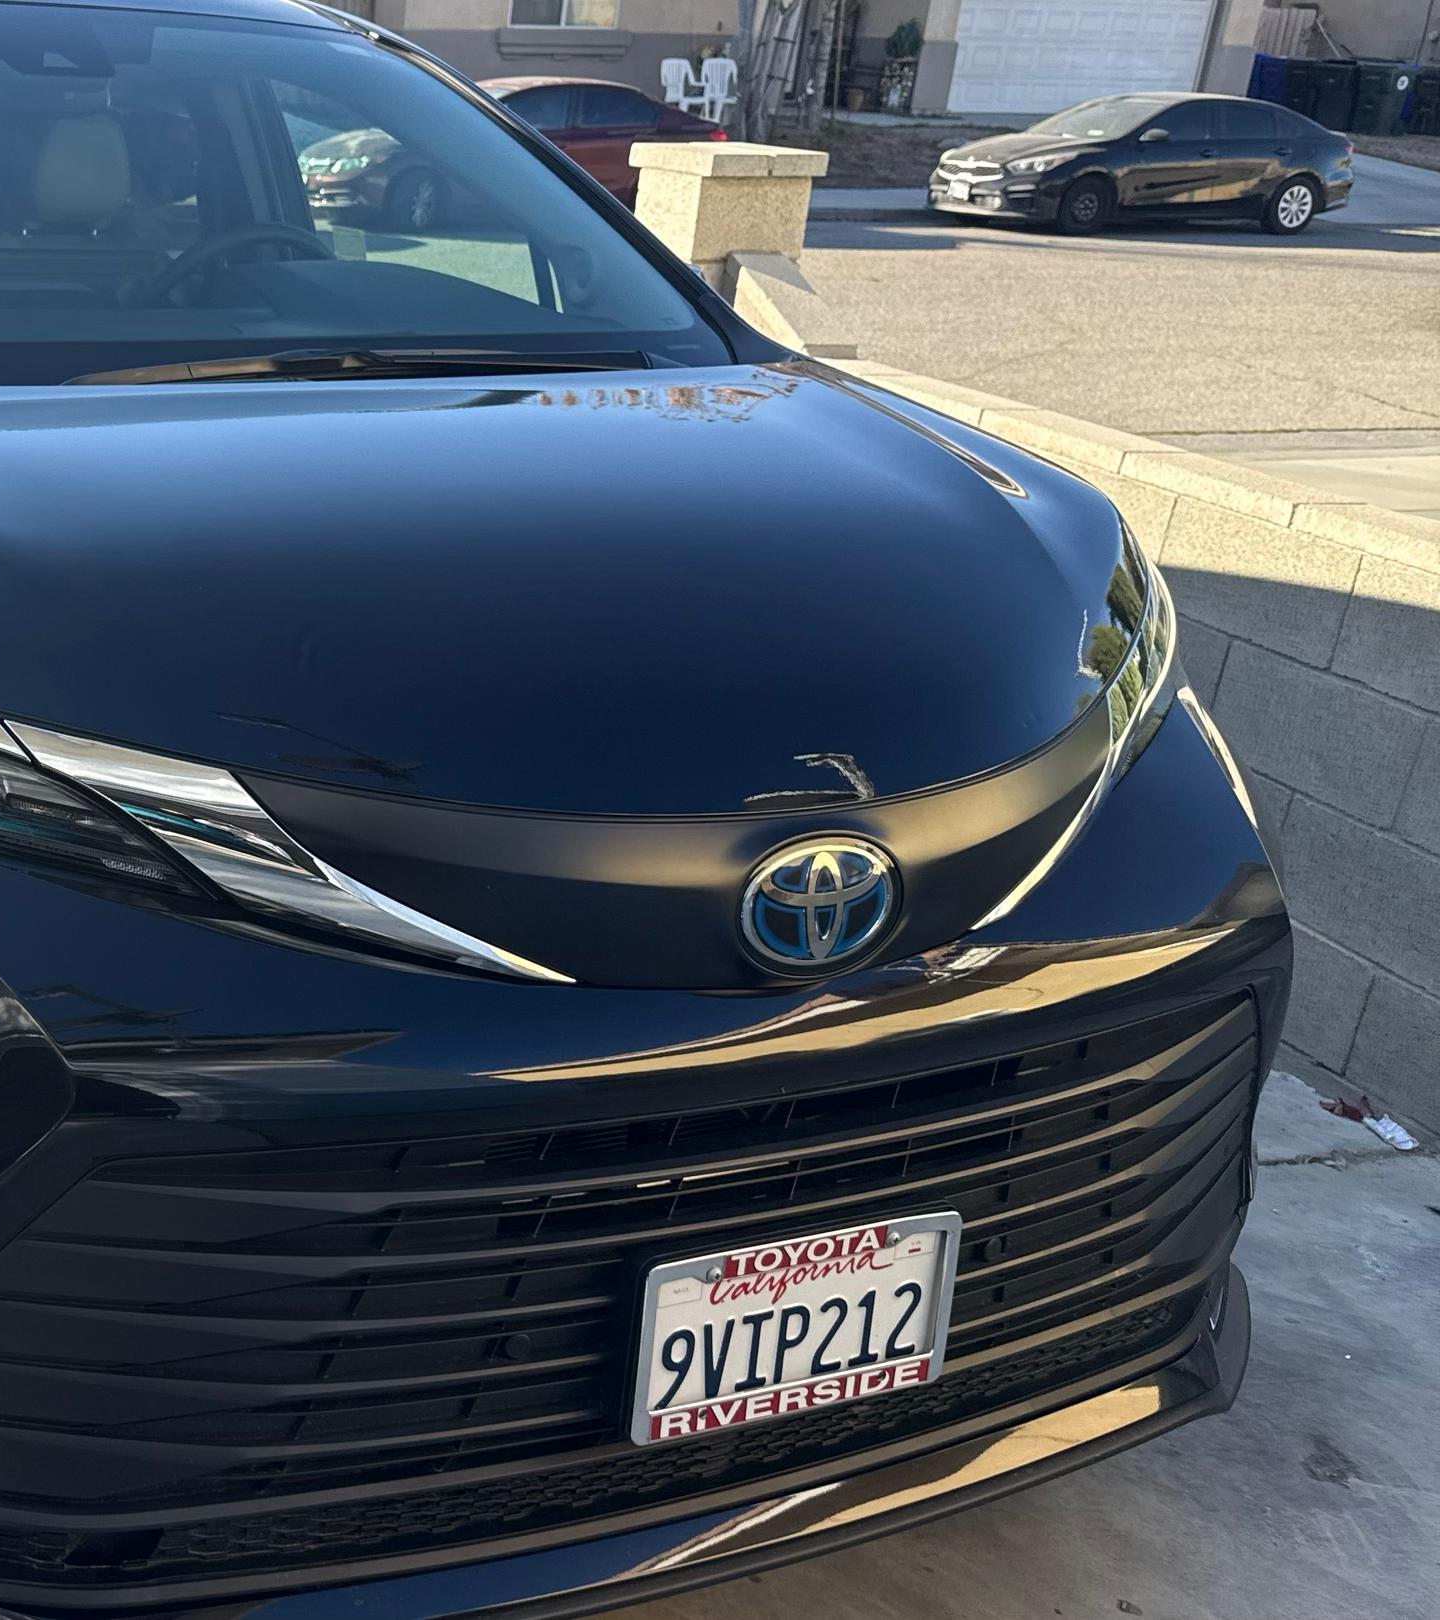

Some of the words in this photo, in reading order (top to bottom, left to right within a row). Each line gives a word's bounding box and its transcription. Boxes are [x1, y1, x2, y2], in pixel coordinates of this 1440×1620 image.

[710, 1251, 893, 1305] California
[731, 1229, 880, 1276] TOYOTA
[654, 1282, 922, 1411] 9VIP212
[660, 1362, 921, 1438] RIVERSIDE
